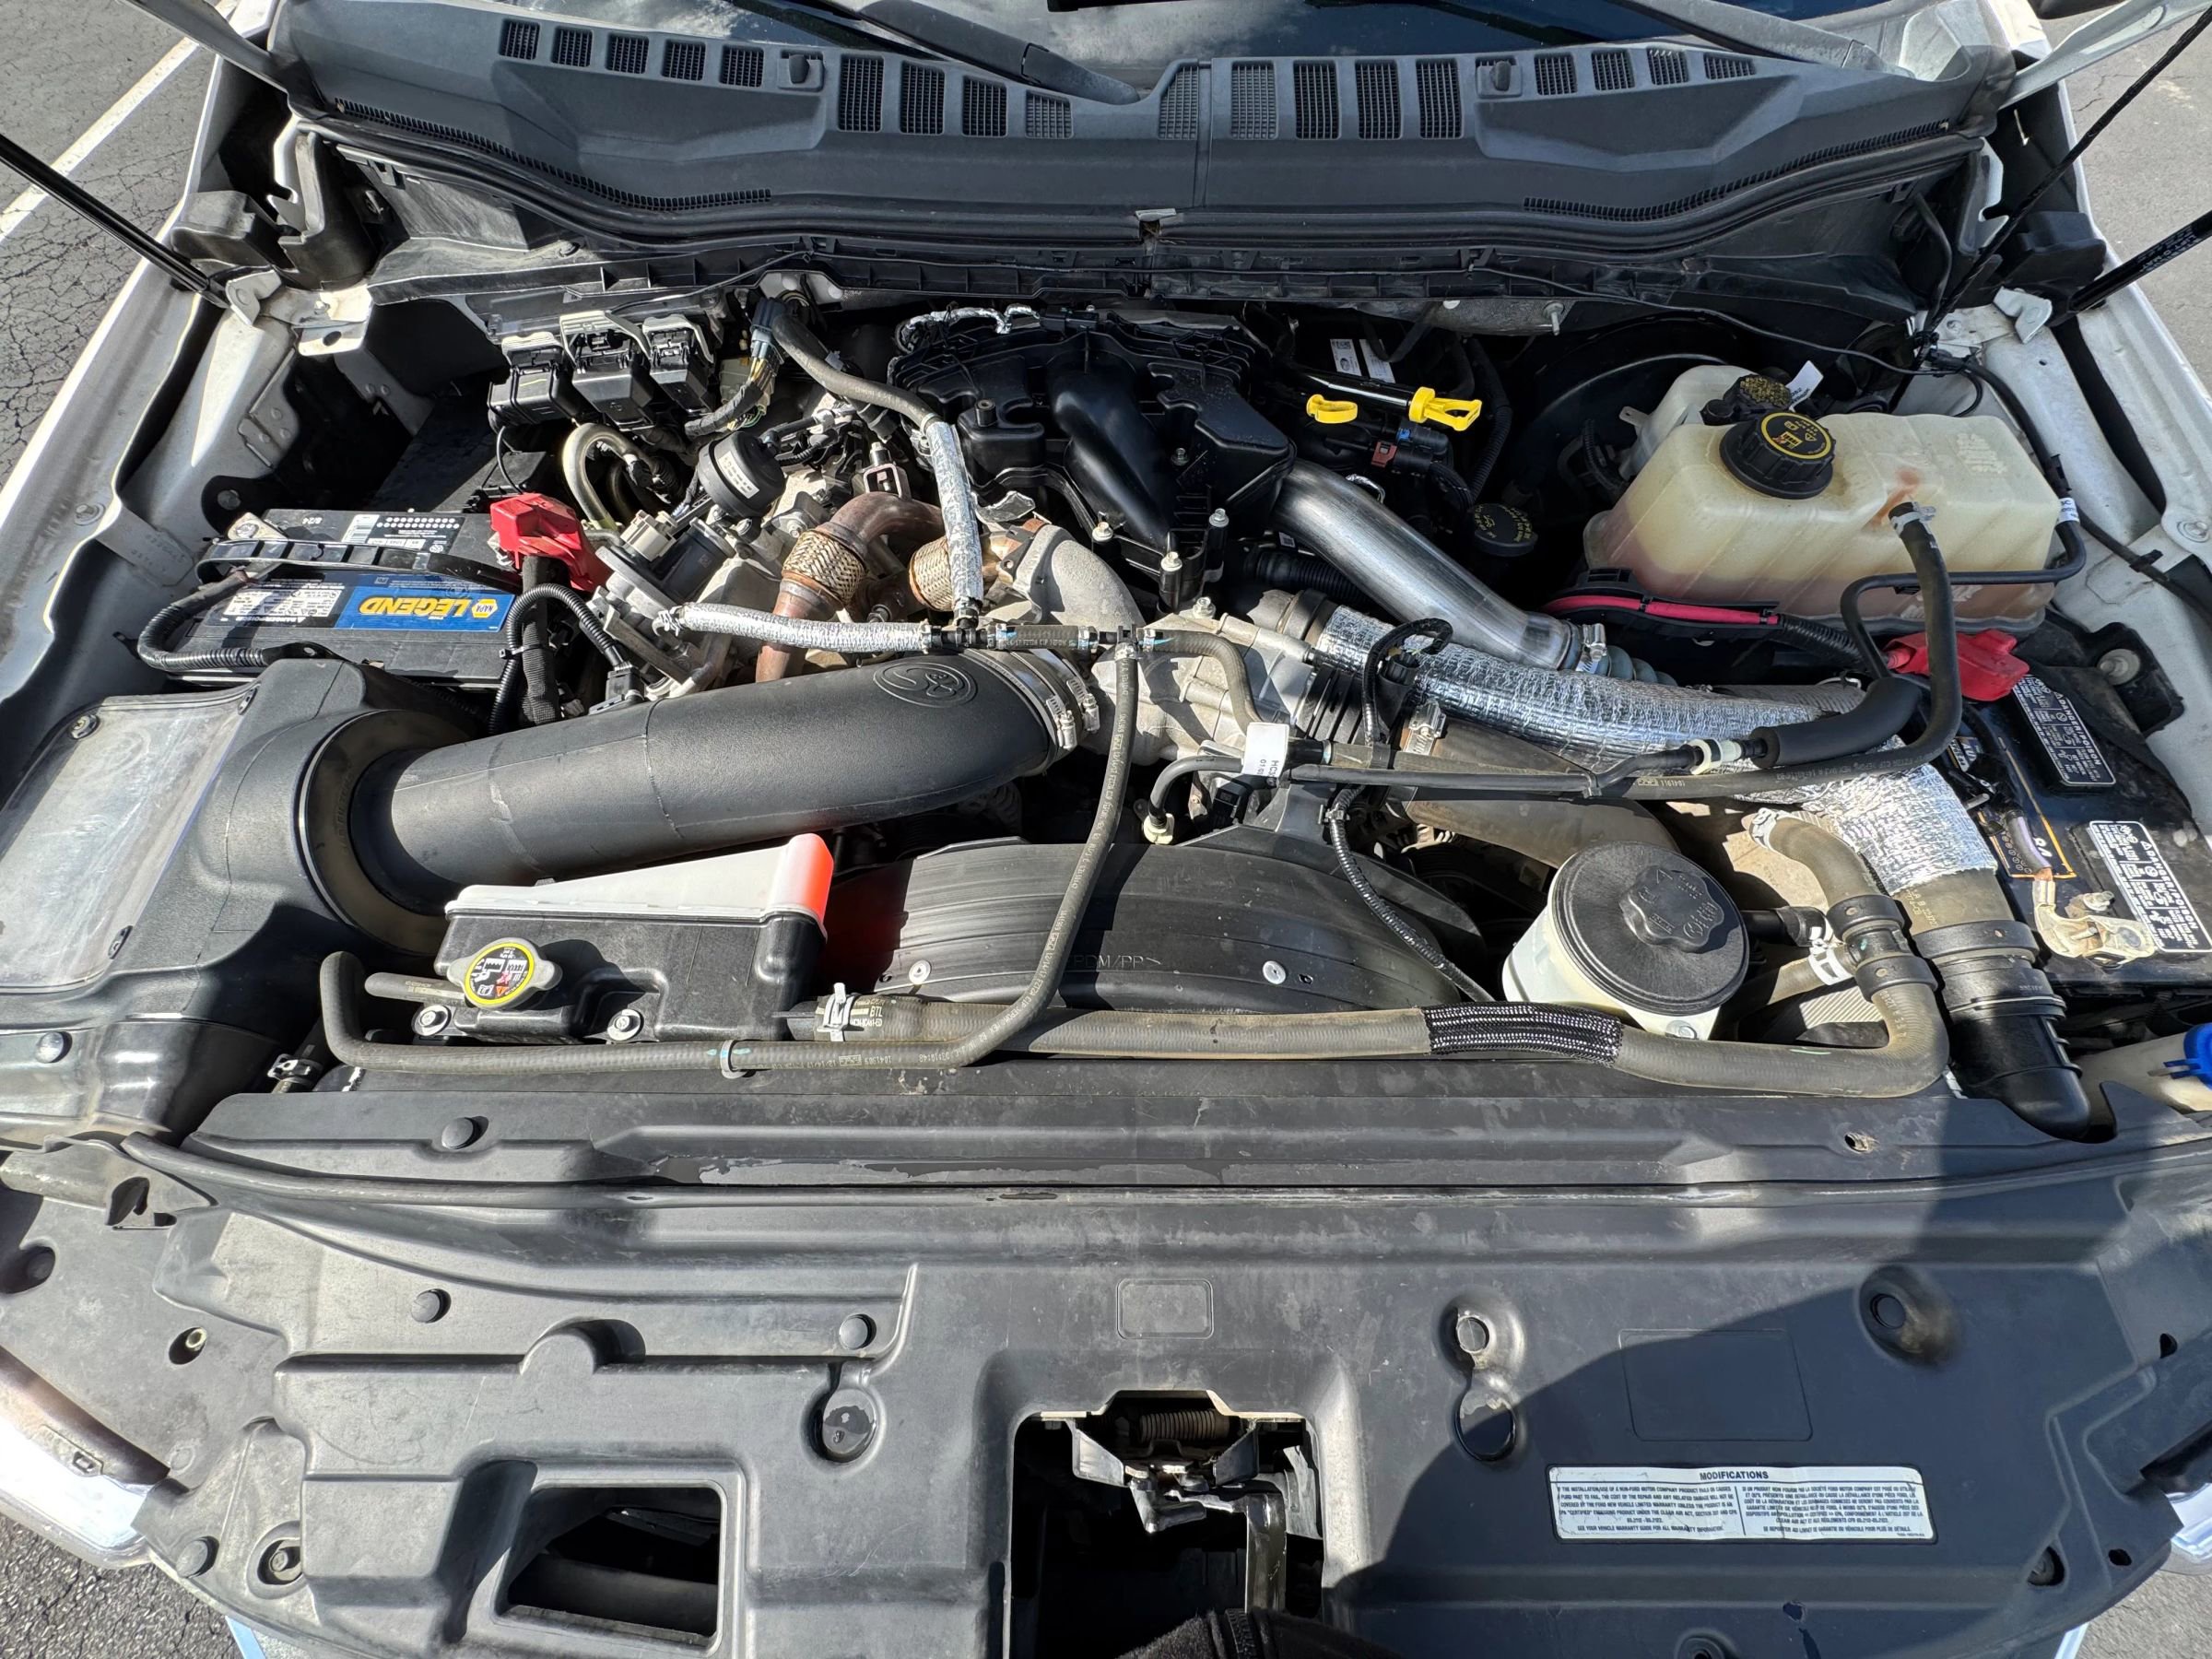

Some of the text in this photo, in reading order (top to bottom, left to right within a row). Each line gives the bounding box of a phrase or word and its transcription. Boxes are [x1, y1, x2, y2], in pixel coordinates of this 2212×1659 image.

[359, 596, 469, 618] LEGEND
[476, 603, 494, 613] NAPA
[1268, 759, 1280, 777] HC3
[1700, 1471, 1770, 1480] MODIFICATIONS
